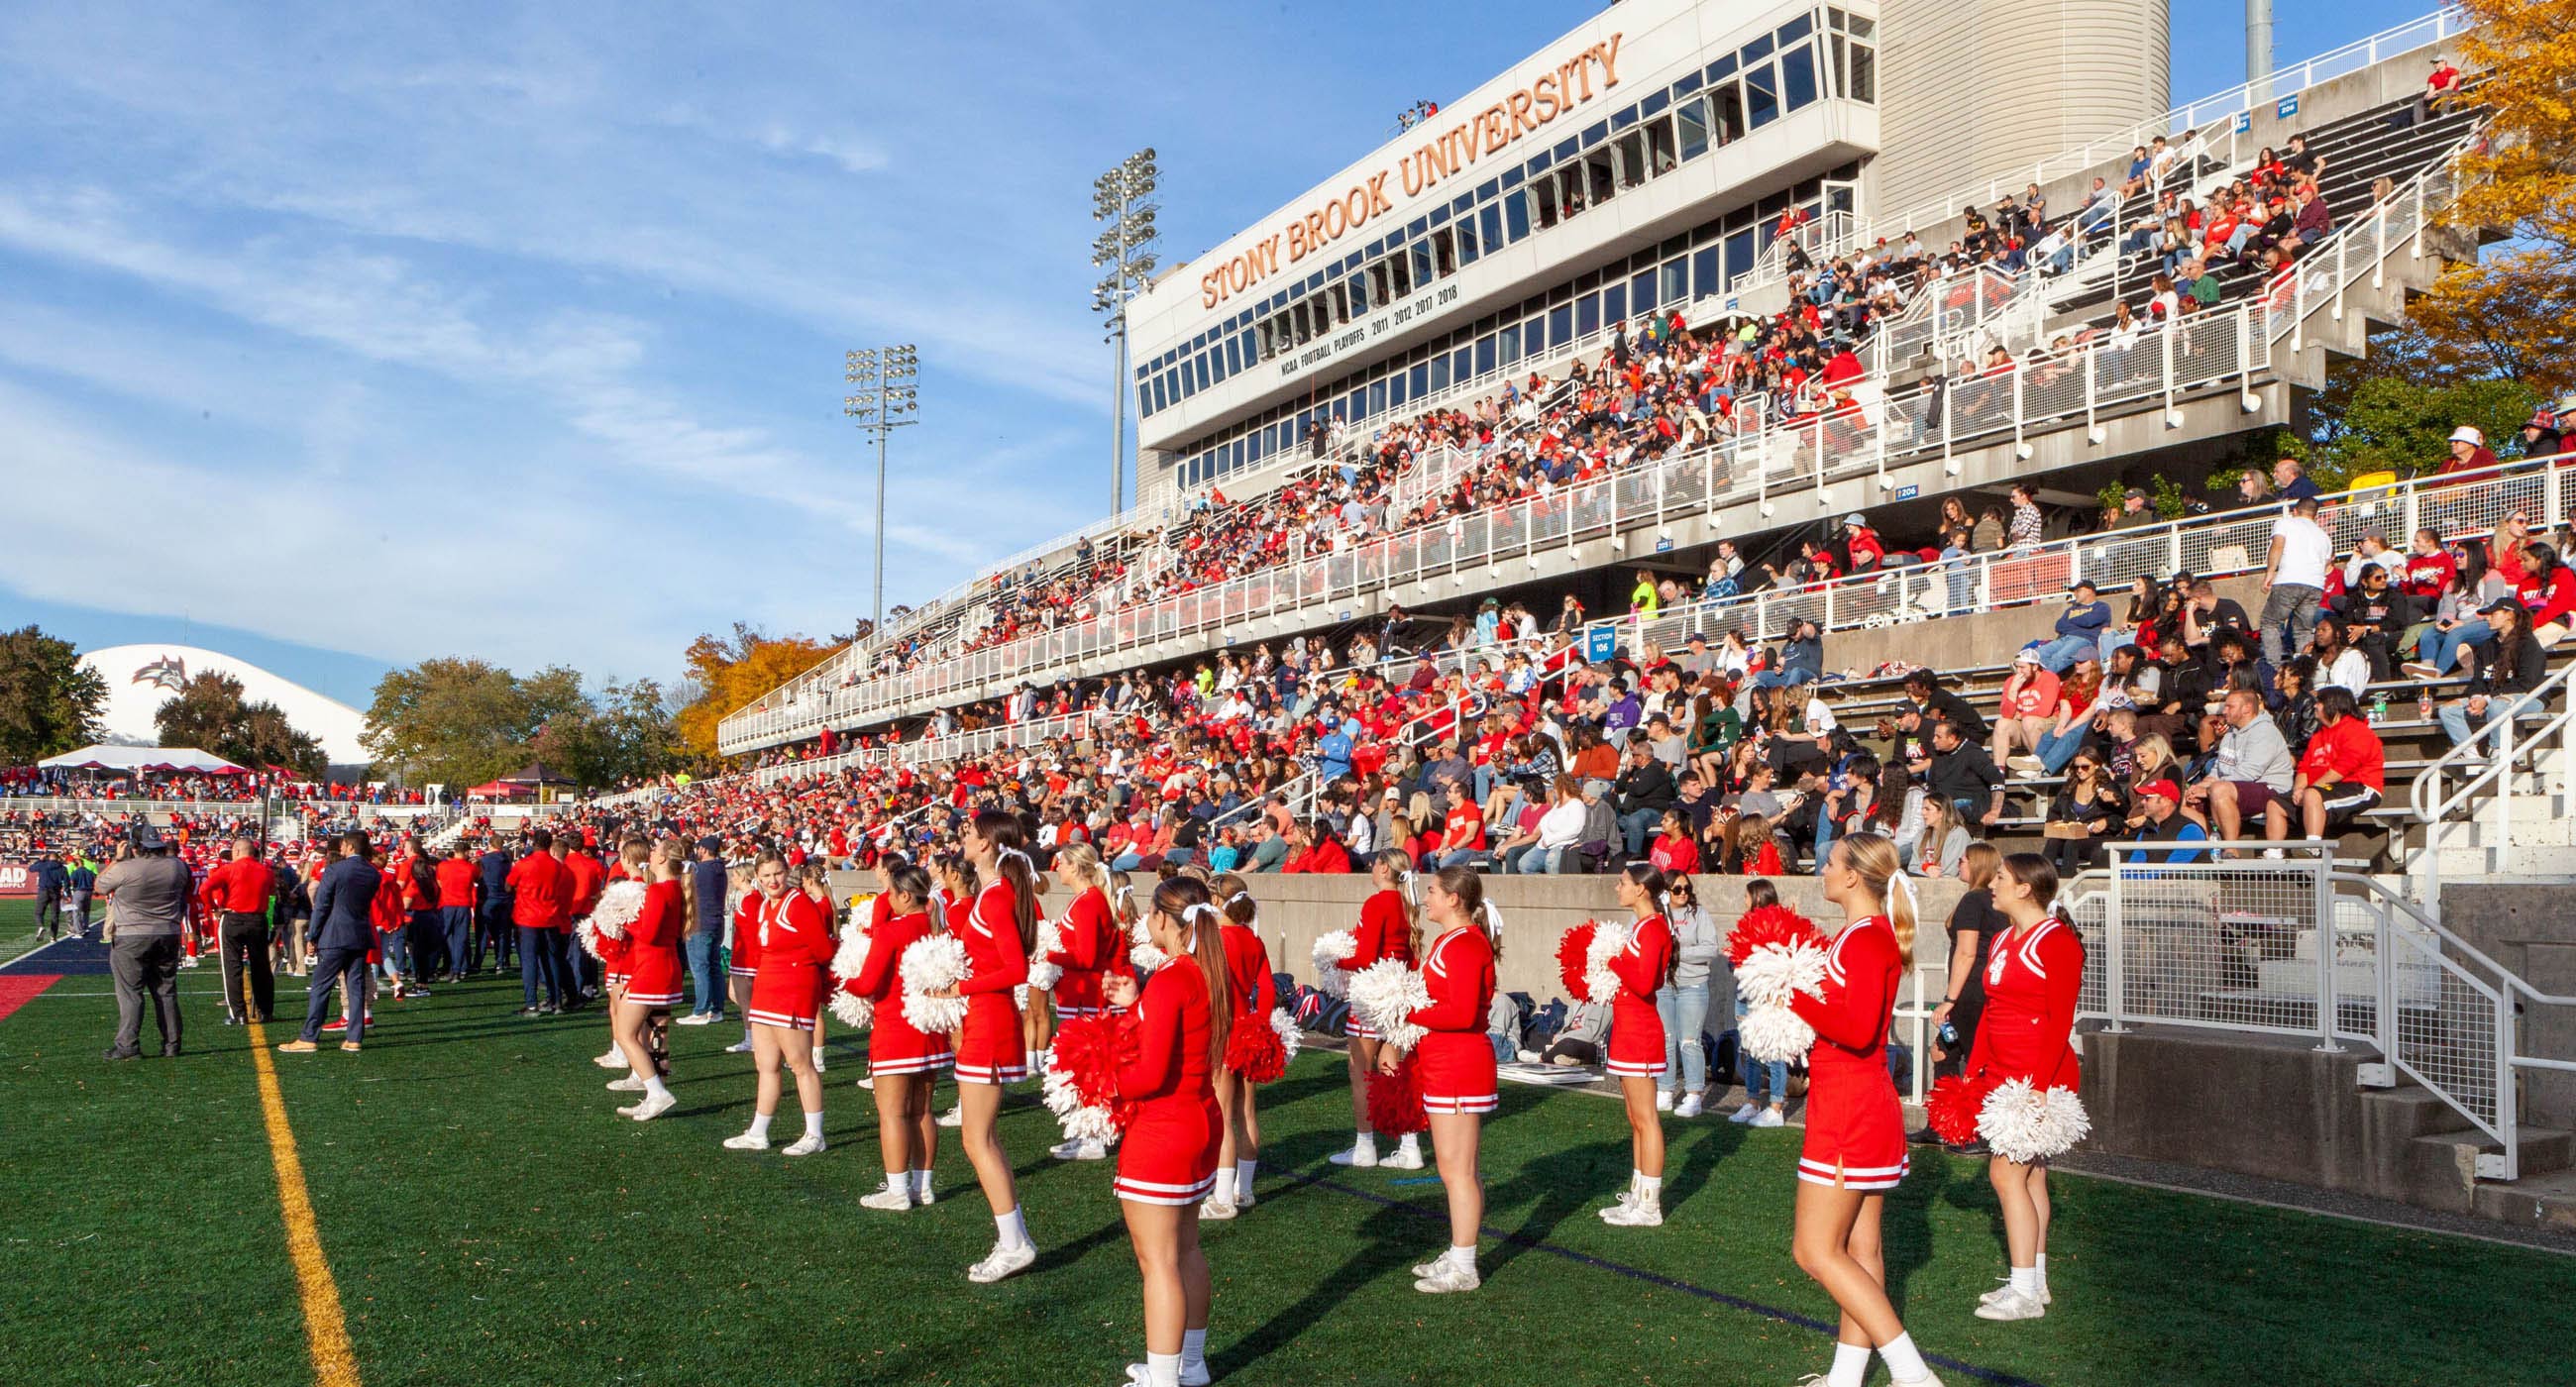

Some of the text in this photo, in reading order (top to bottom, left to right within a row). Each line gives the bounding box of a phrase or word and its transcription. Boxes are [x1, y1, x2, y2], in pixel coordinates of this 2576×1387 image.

[2281, 104, 2296, 114] 206
[1201, 32, 1623, 310] STONY BROOK UNIVERSITY
[1281, 284, 1458, 376] NCAA FOOTBALL PLAYOFFS 2011 2012 2017 2018
[1902, 486, 1917, 497] 206
[1658, 541, 1668, 550] 205
[1592, 633, 1613, 642] SECTION
[1596, 643, 1609, 653] 106
